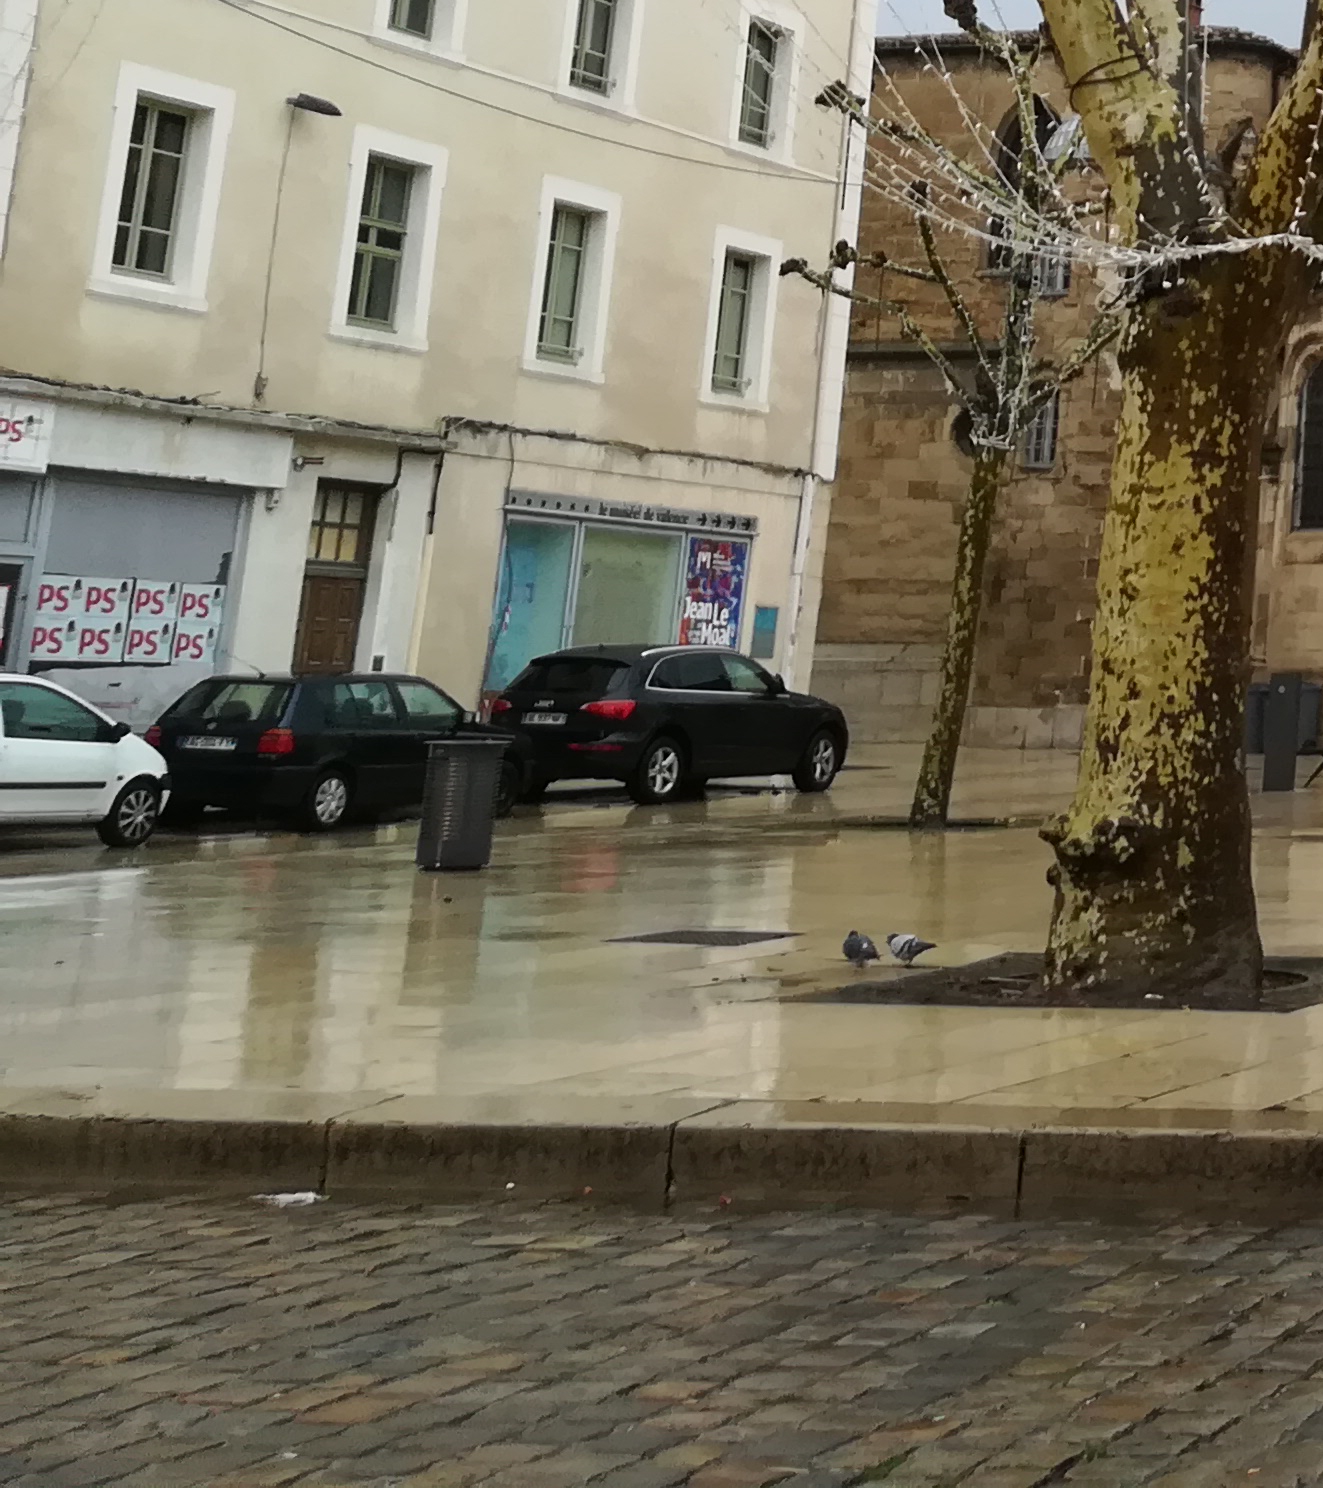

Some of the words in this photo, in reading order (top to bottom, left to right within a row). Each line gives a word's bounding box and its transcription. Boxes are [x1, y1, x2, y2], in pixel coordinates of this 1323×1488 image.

[36, 584, 70, 612] PS
[85, 586, 117, 613] PS
[135, 588, 165, 615] PS
[180, 592, 210, 618] PS
[684, 596, 713, 620] Jean
[713, 601, 730, 626] Le
[30, 626, 63, 654] PS
[78, 627, 111, 655] PS
[127, 629, 160, 656] PS
[174, 633, 204, 659] PS
[701, 622, 731, 646] Moal
